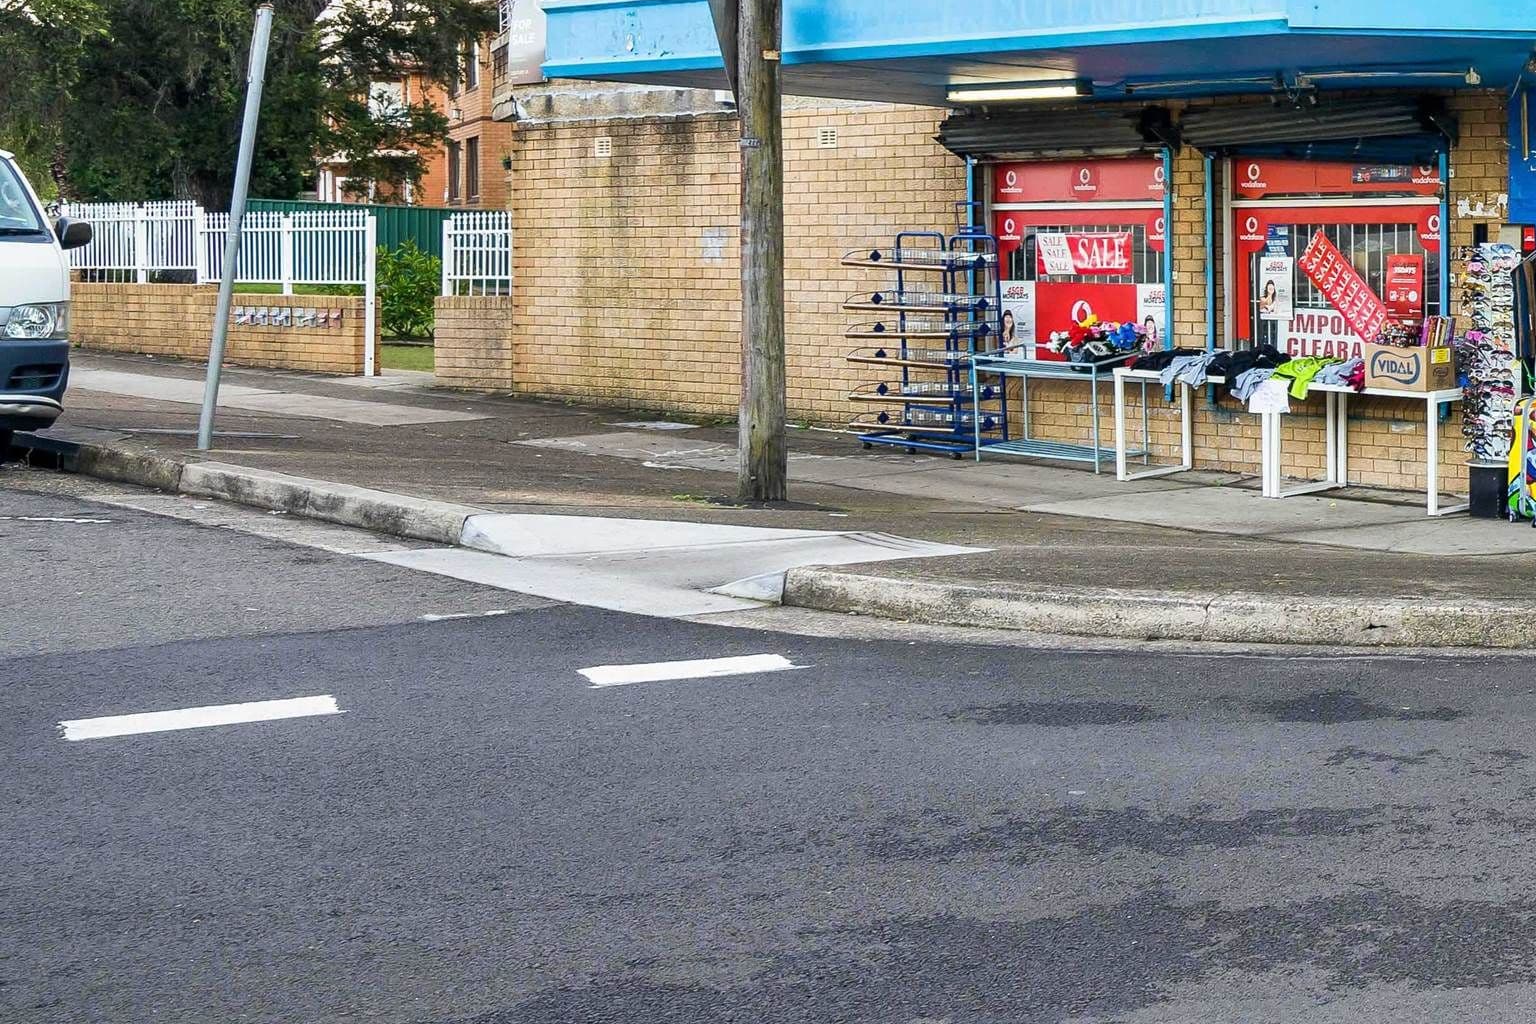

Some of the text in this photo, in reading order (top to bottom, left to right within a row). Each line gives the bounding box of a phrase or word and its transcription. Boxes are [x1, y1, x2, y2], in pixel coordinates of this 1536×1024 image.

[1240, 180, 1267, 188] vodafone
[1042, 236, 1063, 246] SALE
[1239, 233, 1265, 241] vodafone
[1047, 248, 1067, 258] SALE
[1049, 261, 1070, 271] SALE
[1078, 237, 1127, 269] SALE
[1307, 241, 1327, 272] SALE
[1315, 251, 1336, 281] SALE
[1322, 261, 1343, 292] SALE
[1331, 271, 1352, 301] SALE
[1339, 280, 1360, 311] SALE
[1347, 290, 1368, 321] SALE
[1356, 299, 1377, 331] SALE
[1364, 310, 1385, 341] SALE
[1377, 359, 1413, 375] VIDAL
